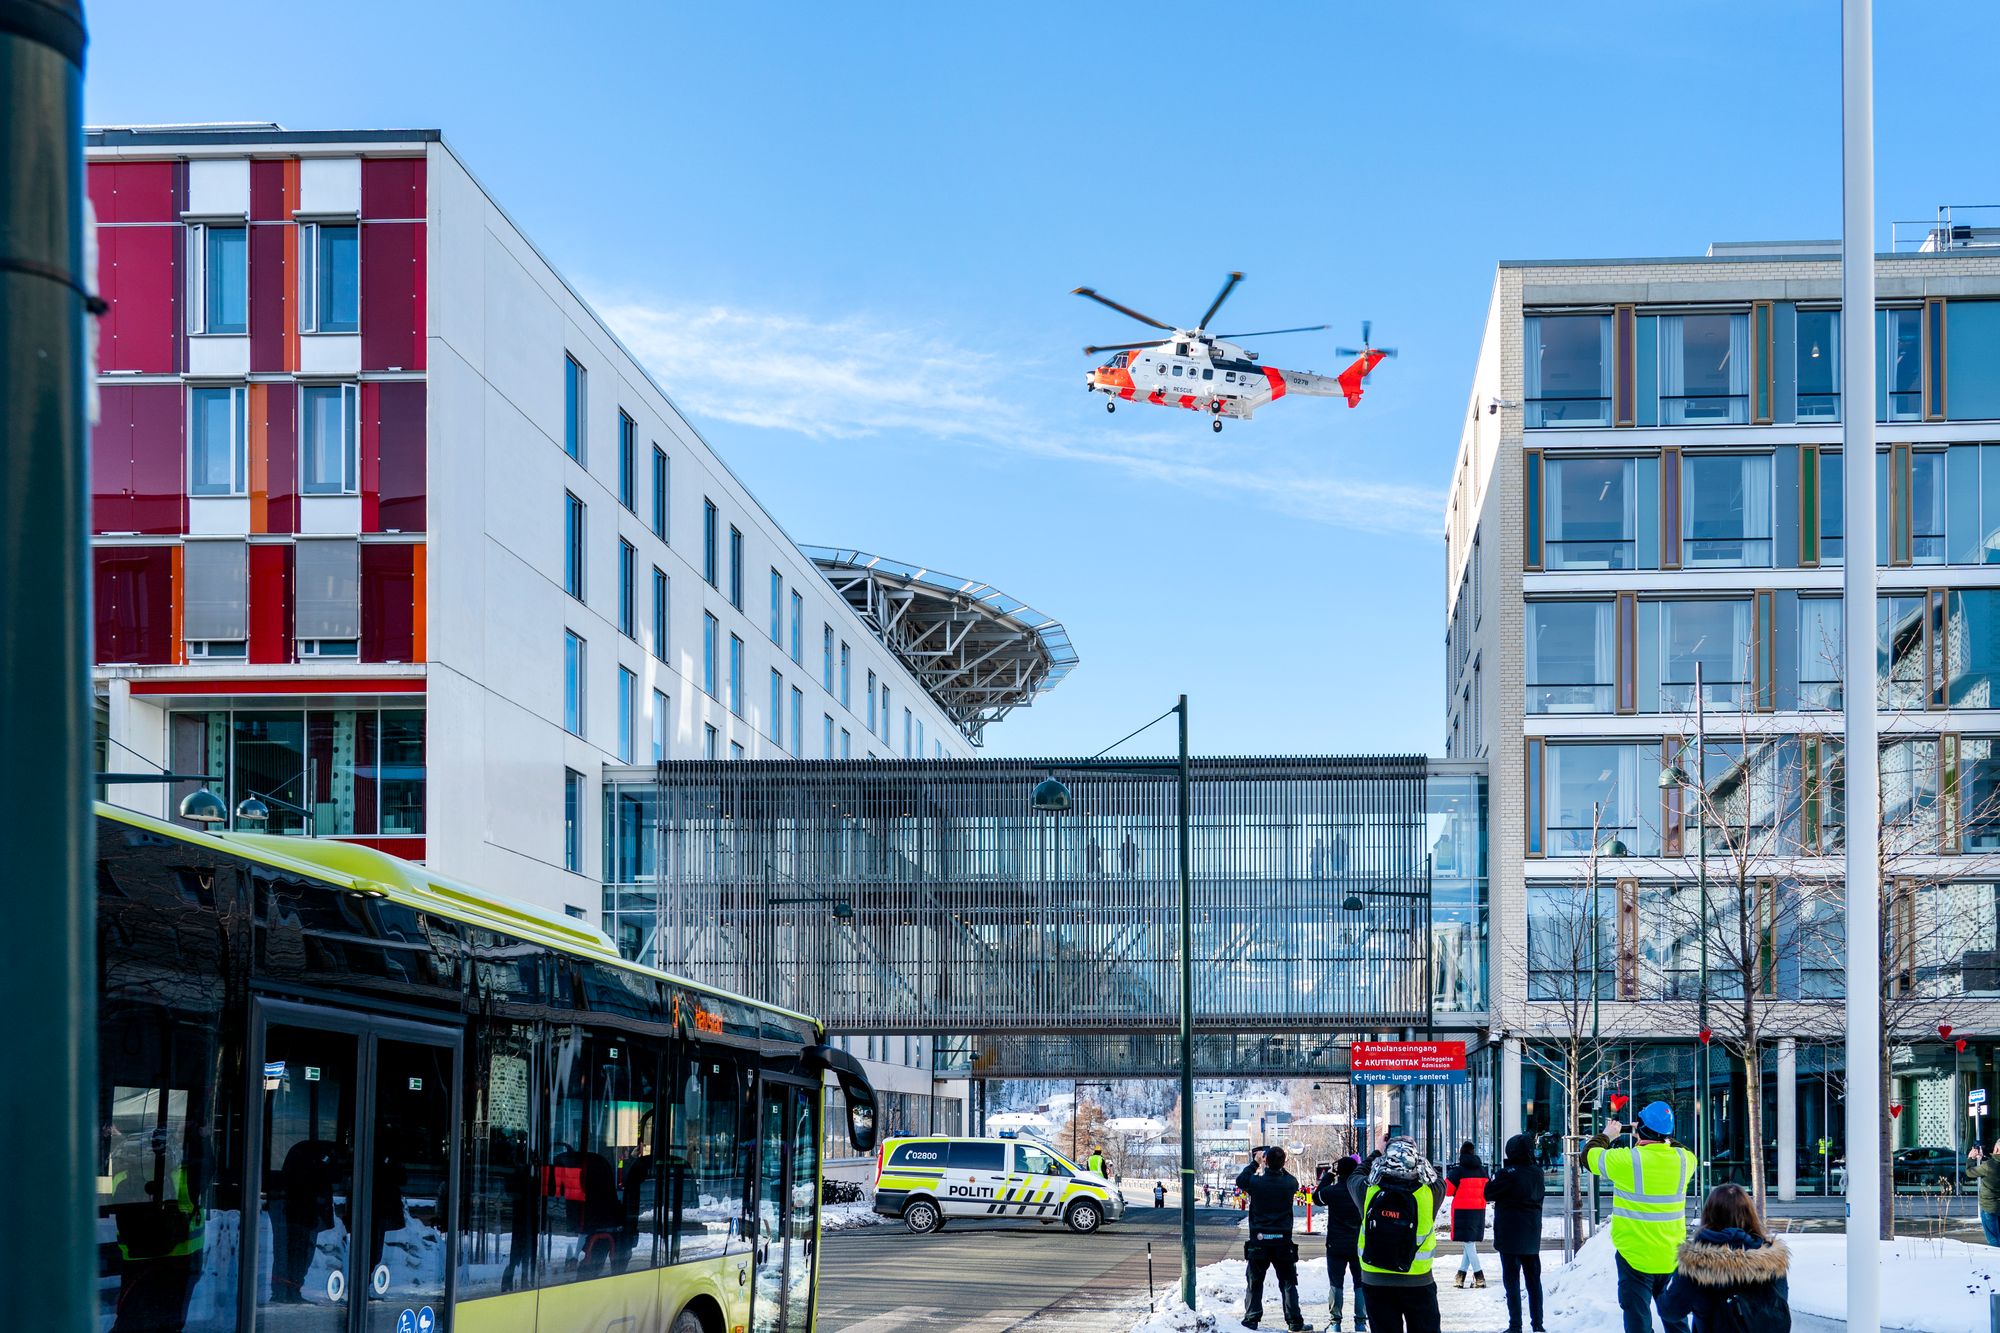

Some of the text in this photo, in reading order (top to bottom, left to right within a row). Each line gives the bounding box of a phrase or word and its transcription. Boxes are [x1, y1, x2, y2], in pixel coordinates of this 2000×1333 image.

[1173, 386, 1193, 394] RESCUE
[1365, 1045, 1437, 1054] Ambulanseinngang
[1364, 1059, 1419, 1067] AKUTTMOTTAK
[1363, 1073, 1386, 1081] Hjerte
[1392, 1073, 1412, 1081] lunge
[912, 1152, 938, 1160] 02800
[949, 1185, 994, 1198] POLITI
[1381, 1210, 1400, 1219] COWI
